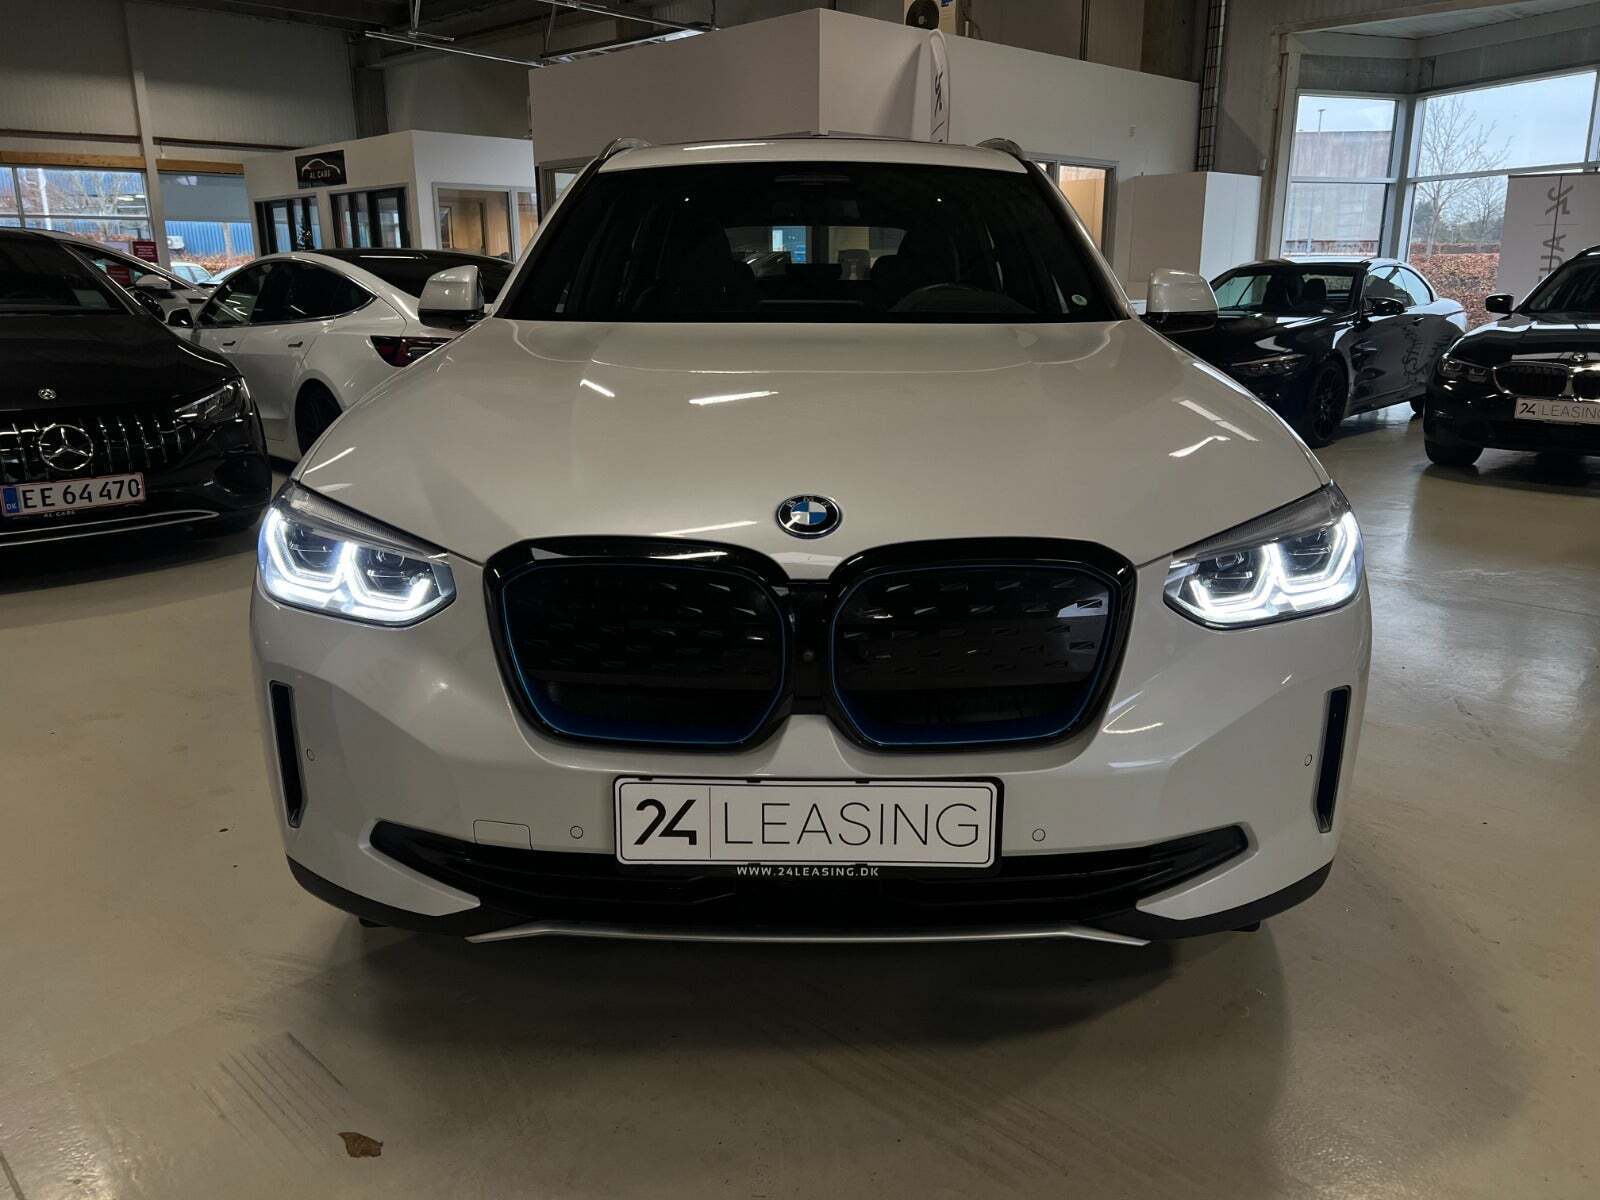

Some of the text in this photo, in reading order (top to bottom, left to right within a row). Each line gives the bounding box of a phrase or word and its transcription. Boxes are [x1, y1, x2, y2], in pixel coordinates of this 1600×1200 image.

[1520, 403, 1536, 415] 24
[22, 489, 55, 509] EE
[62, 484, 93, 505] 64
[99, 478, 140, 501] 470
[633, 798, 980, 847] 24 LEASING
[736, 866, 879, 877] WWW.24LEASING.DK
